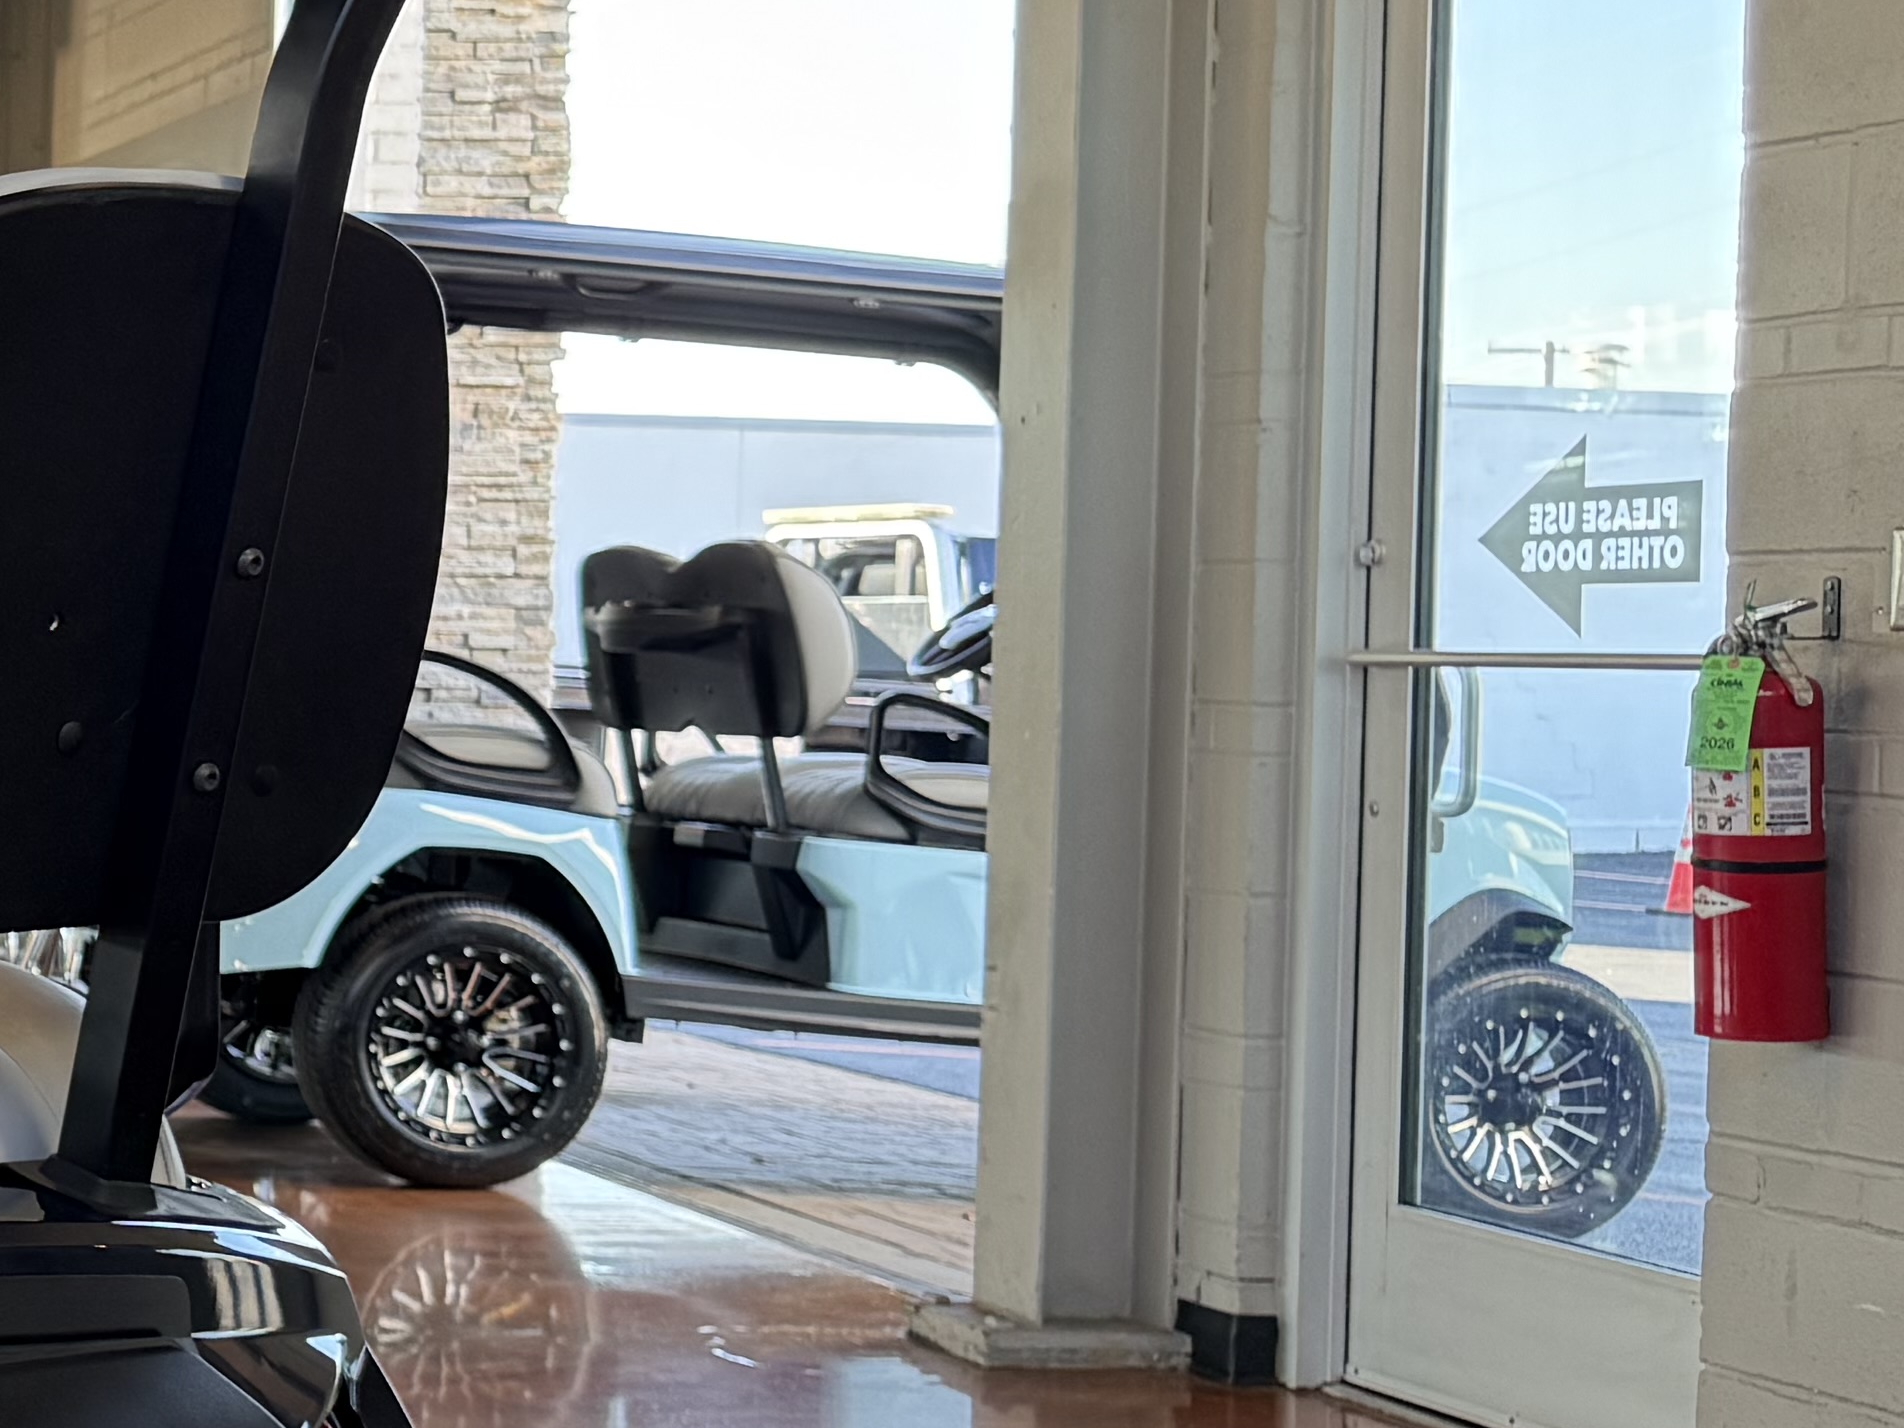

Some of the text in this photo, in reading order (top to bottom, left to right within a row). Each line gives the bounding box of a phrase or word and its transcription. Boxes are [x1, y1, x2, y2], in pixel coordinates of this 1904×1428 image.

[1699, 735, 1735, 751] 2026
[1752, 757, 1760, 771] A
[1753, 786, 1760, 798] B
[1753, 813, 1761, 826] C
